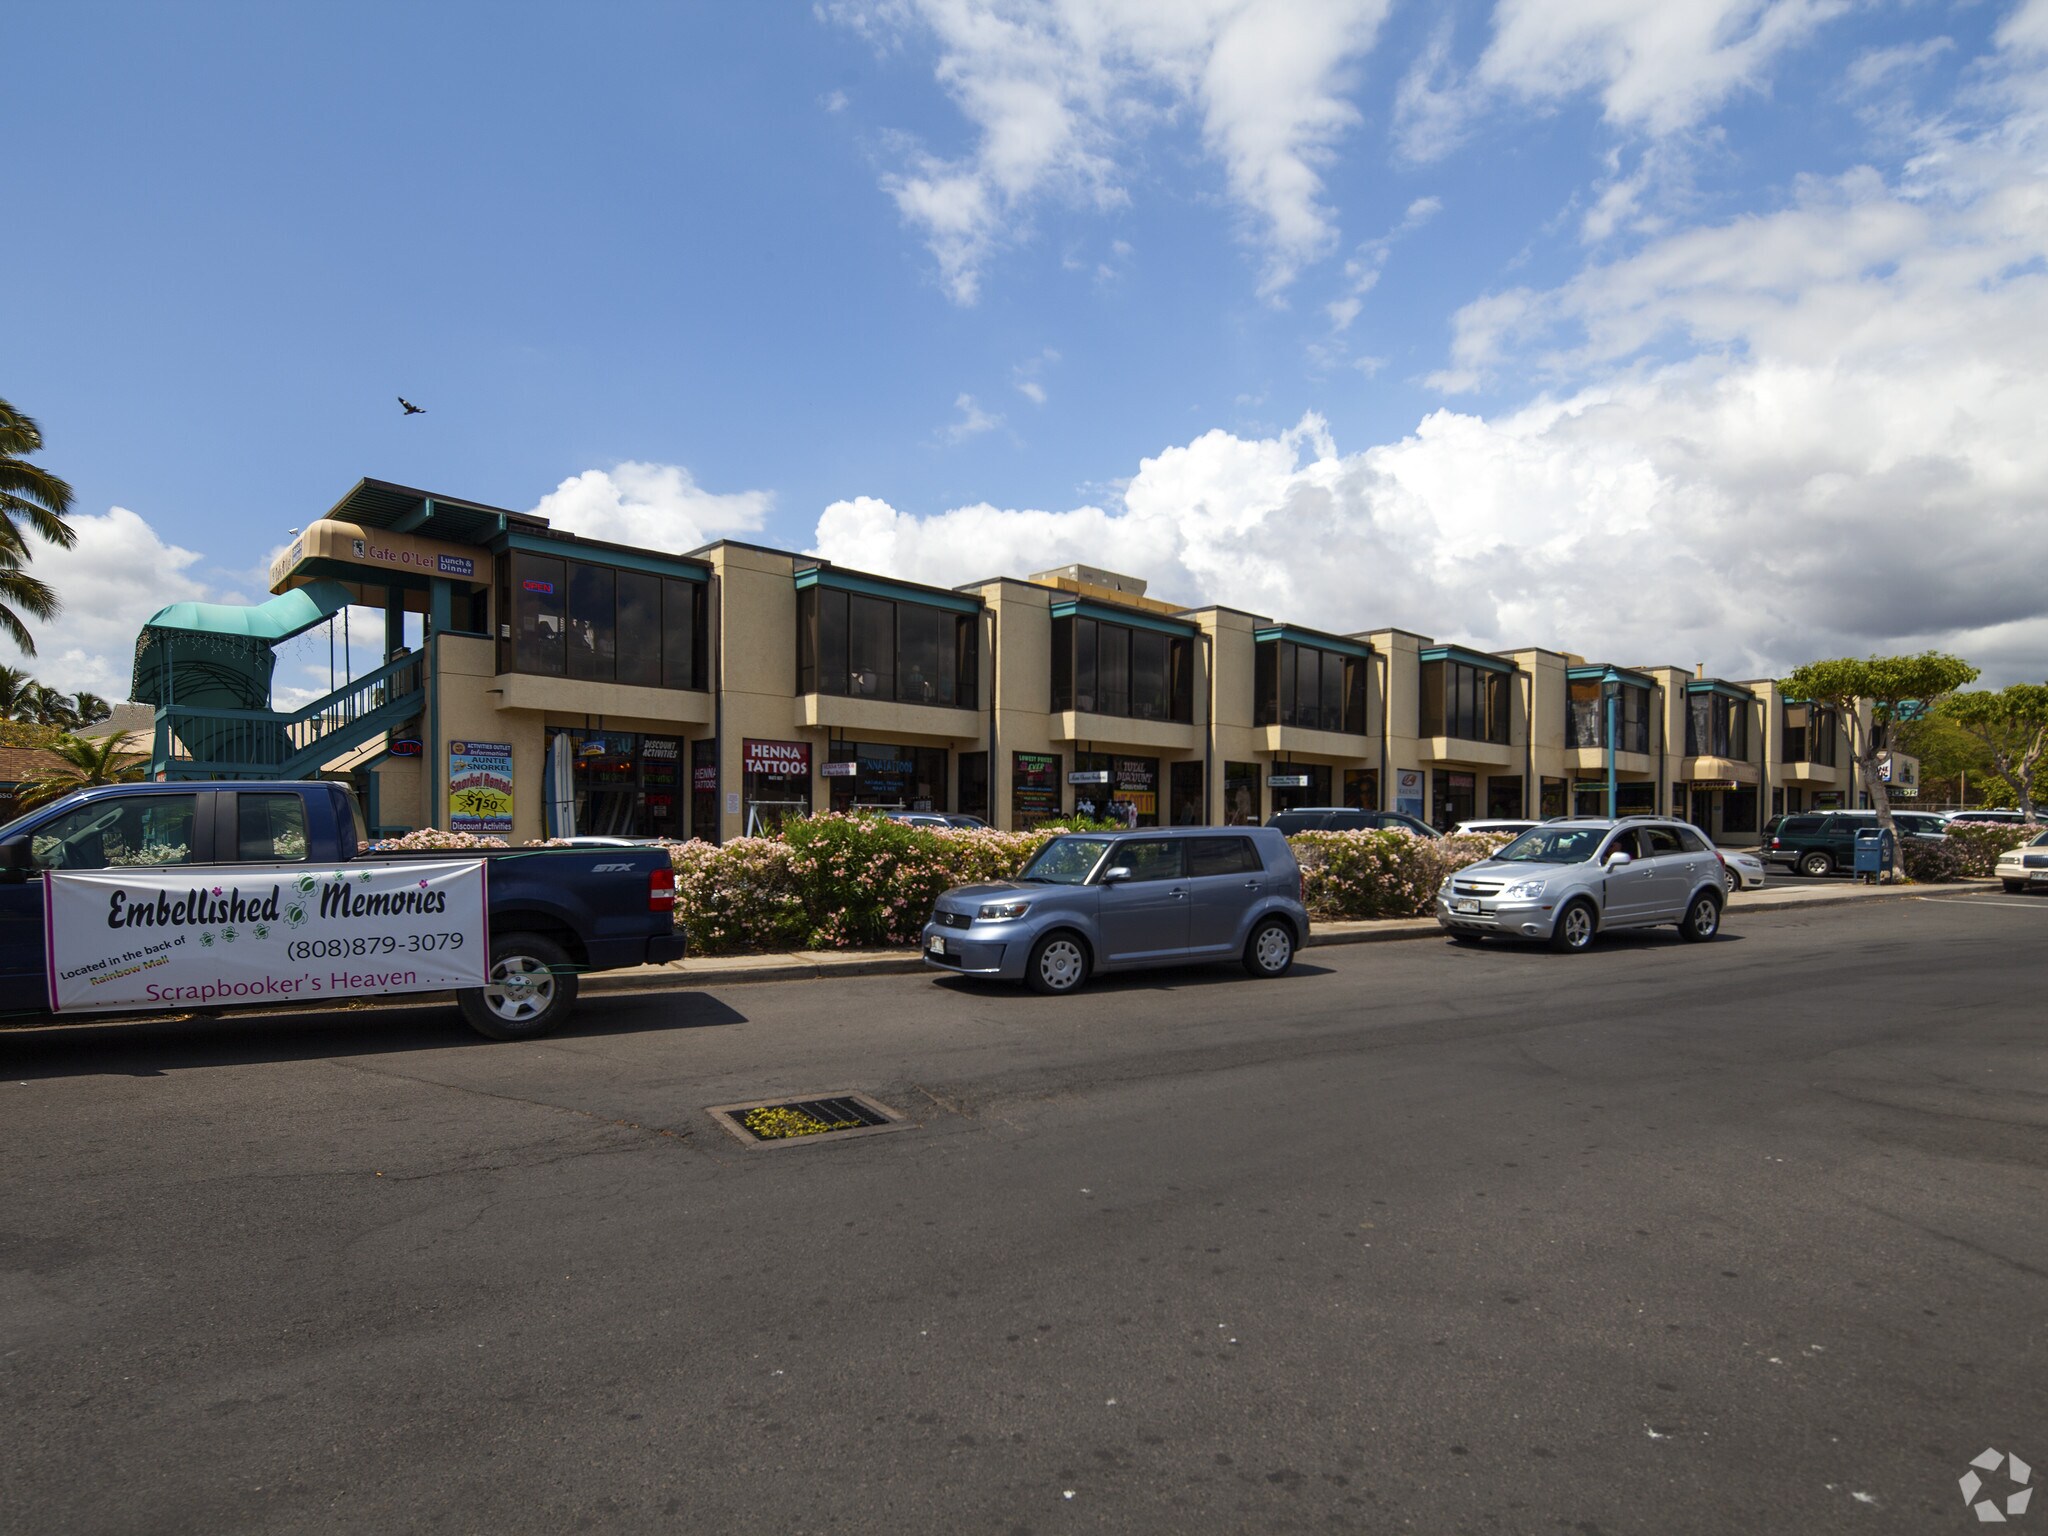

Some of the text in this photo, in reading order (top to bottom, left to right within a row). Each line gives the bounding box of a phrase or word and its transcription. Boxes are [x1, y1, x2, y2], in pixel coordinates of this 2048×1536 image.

[369, 546, 434, 568] Cafe O'Lei
[440, 556, 464, 566] Lunch
[440, 564, 472, 575] Dinner
[522, 581, 551, 593] OPEN
[391, 742, 422, 753] ATM
[644, 739, 677, 750] DISCOUNT
[470, 749, 508, 757] Information
[642, 749, 678, 759] ACTIVITIES
[750, 744, 801, 760] HENNA
[745, 759, 807, 775] TATTOOS
[1028, 763, 1045, 771] EVER
[1123, 762, 1146, 772] TOTAL
[1116, 772, 1153, 784] DISCOUNT
[450, 772, 513, 796] Snorkel Rentals
[1120, 782, 1148, 791] Souvenirs
[452, 821, 512, 830] Discount Activities
[591, 863, 636, 873] STX
[108, 882, 446, 929] Embellished Memories
[287, 932, 464, 962] (808)879-3079
[60, 935, 186, 981] Located in the back of
[90, 955, 170, 986] Rainbow Mall
[146, 971, 417, 1003] Scrapbooker's Heaven
